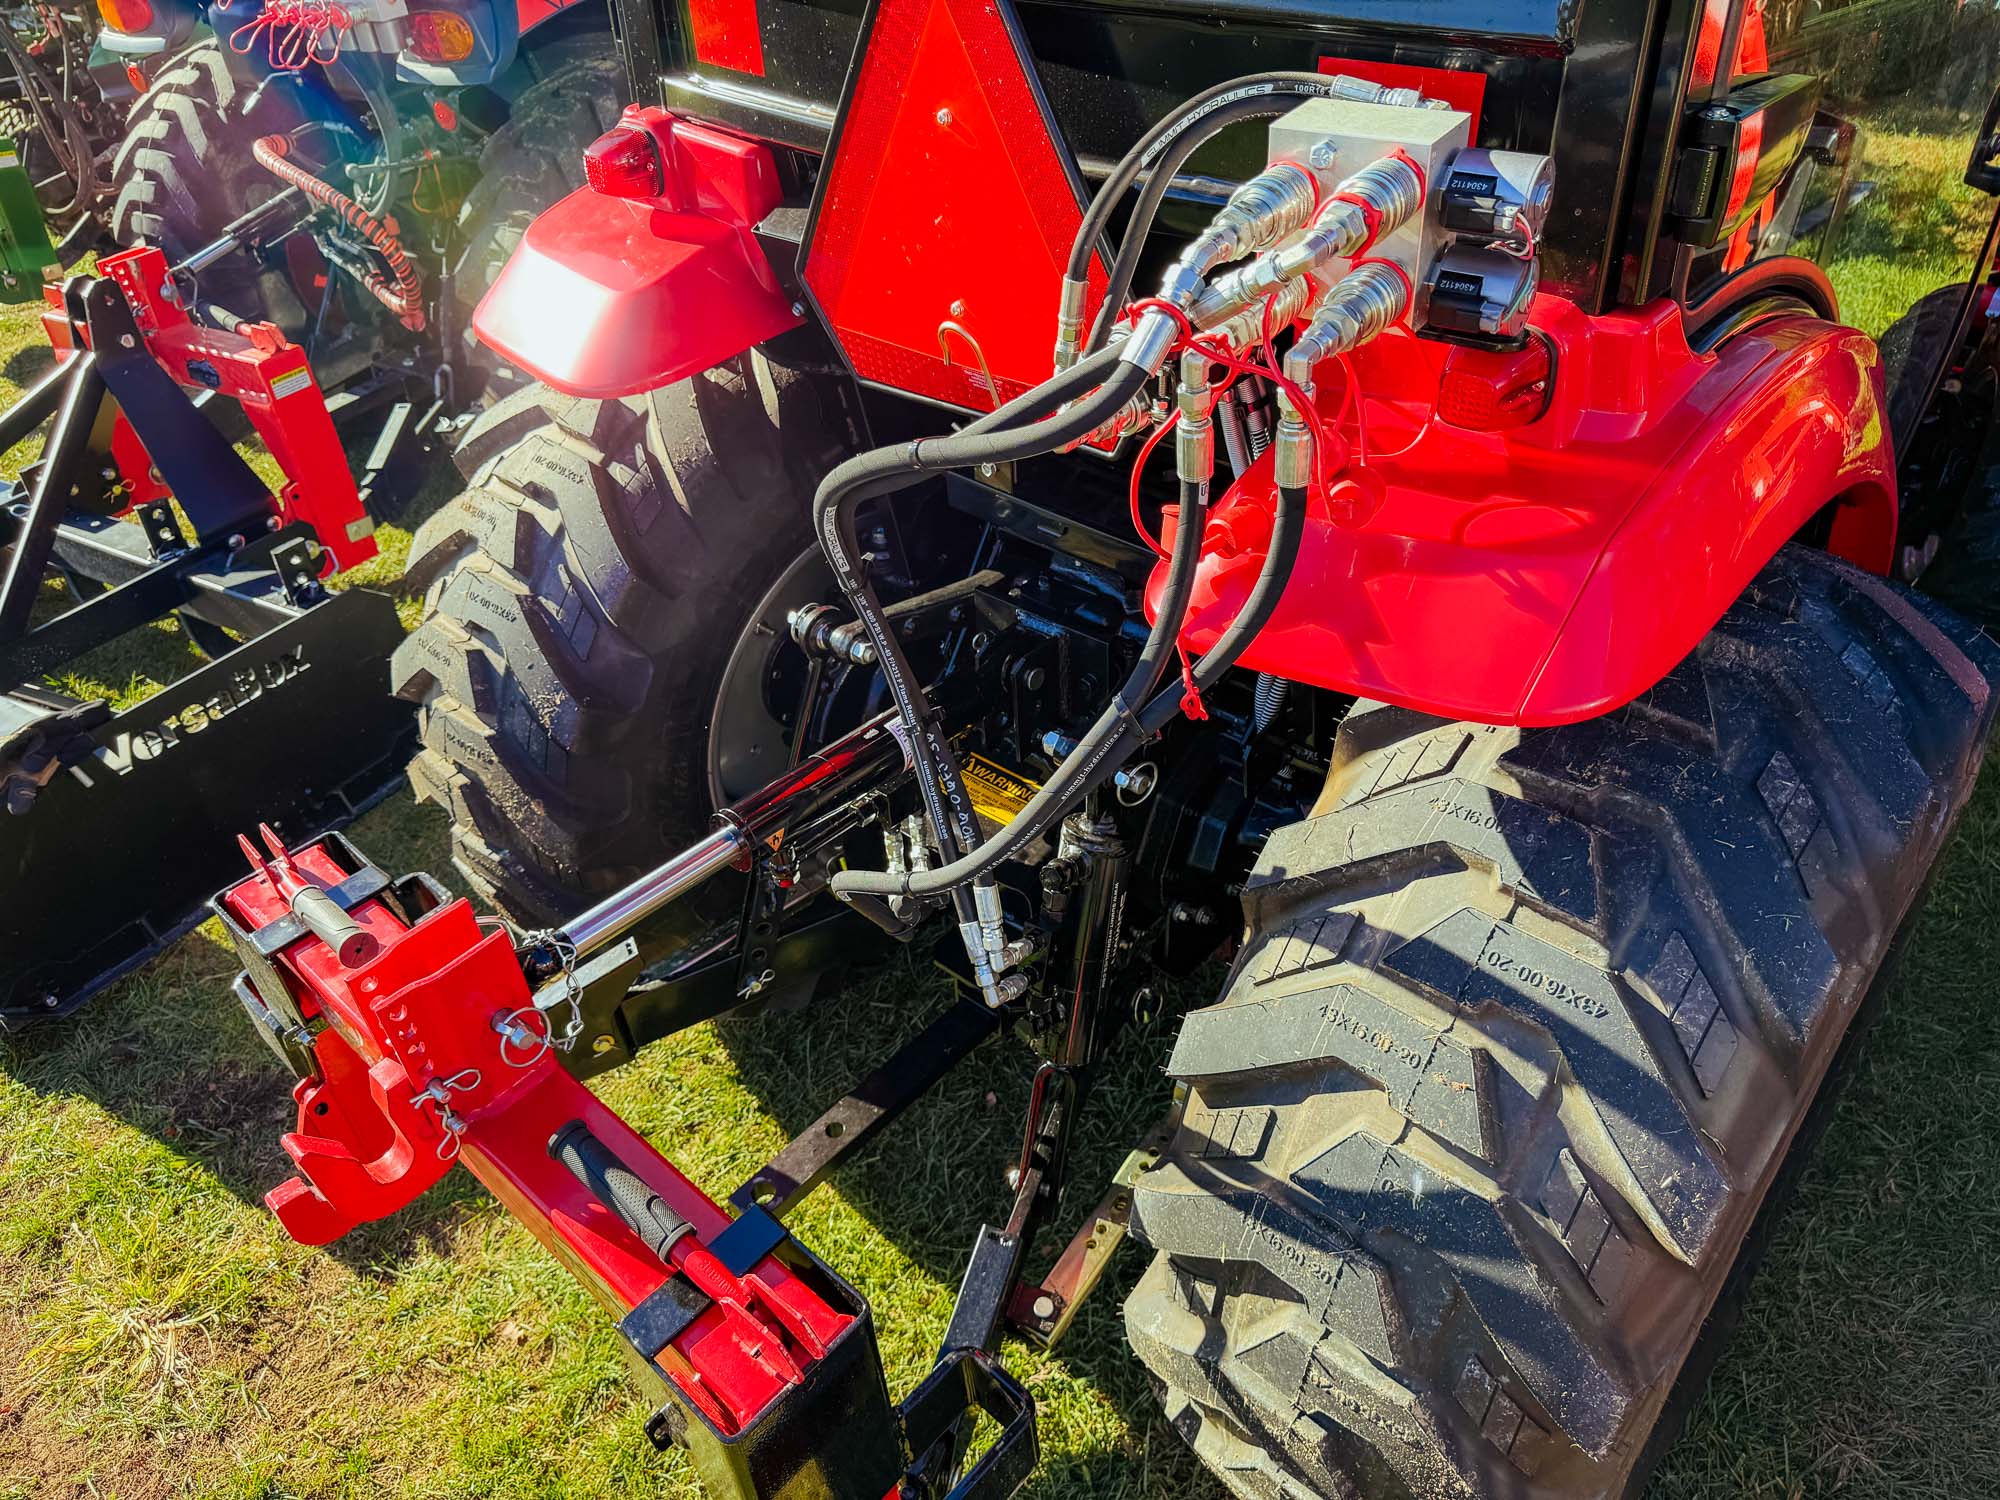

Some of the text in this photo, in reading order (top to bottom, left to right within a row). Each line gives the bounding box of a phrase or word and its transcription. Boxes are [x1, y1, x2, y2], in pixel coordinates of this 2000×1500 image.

[1145, 121, 1185, 159] SUMMIT
[1187, 84, 1266, 124] HYDRAULICS
[1451, 179, 1488, 191] 4304112
[1440, 279, 1476, 292] 4304112
[872, 622, 881, 634] PSI
[896, 683, 911, 703] Flame
[922, 760, 949, 840] summit-hydraulics.com
[1011, 823, 1041, 852] Resistant
[1486, 950, 1610, 1020] 43X16.00-20
[1318, 1003, 1423, 1070] 43X16.00-20
